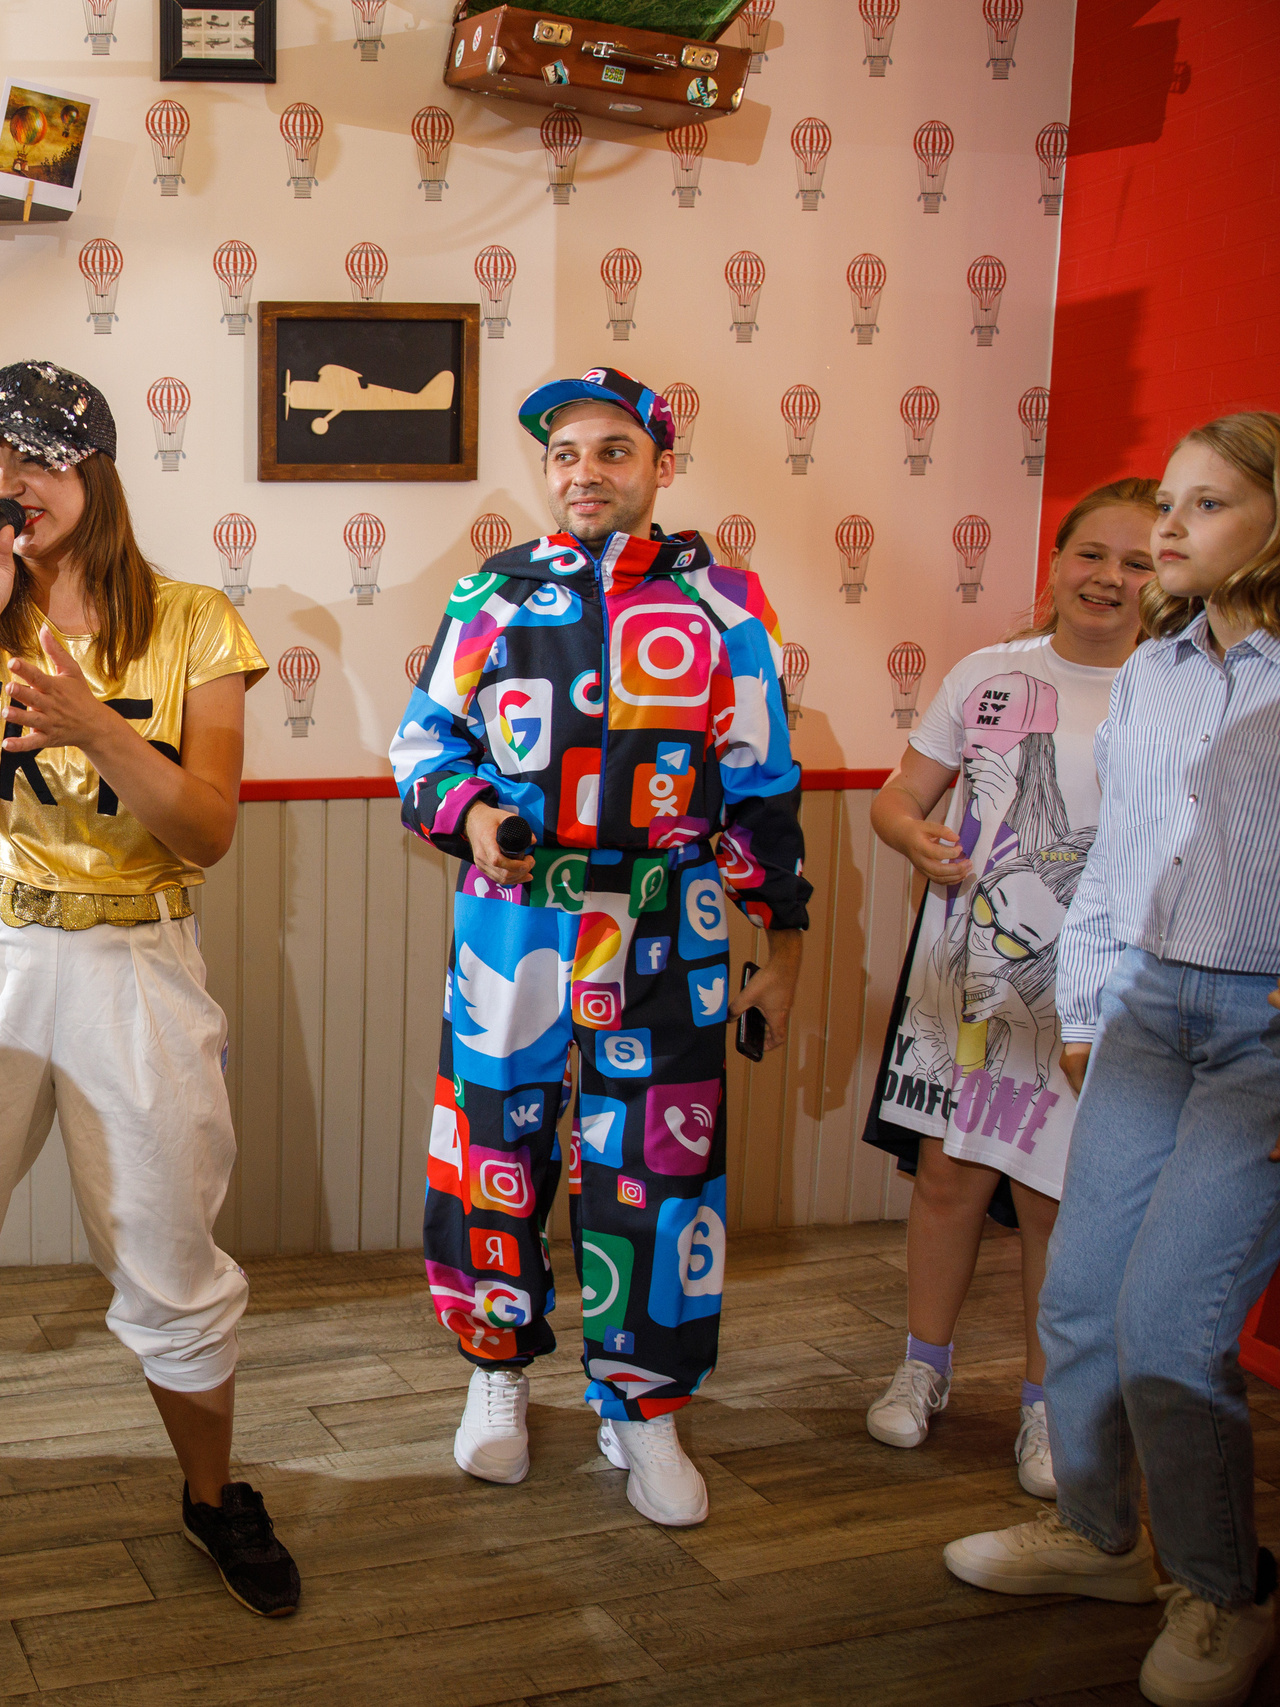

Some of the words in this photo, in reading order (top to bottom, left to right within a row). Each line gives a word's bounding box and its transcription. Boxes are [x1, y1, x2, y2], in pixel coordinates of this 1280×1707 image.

[982, 690, 1011, 701] AVE
[976, 715, 1001, 726] ME
[1040, 851, 1079, 862] TRICK
[648, 942, 662, 970] f
[615, 1041, 636, 1063] S
[485, 1236, 504, 1267] Я
[614, 1333, 625, 1351] f
